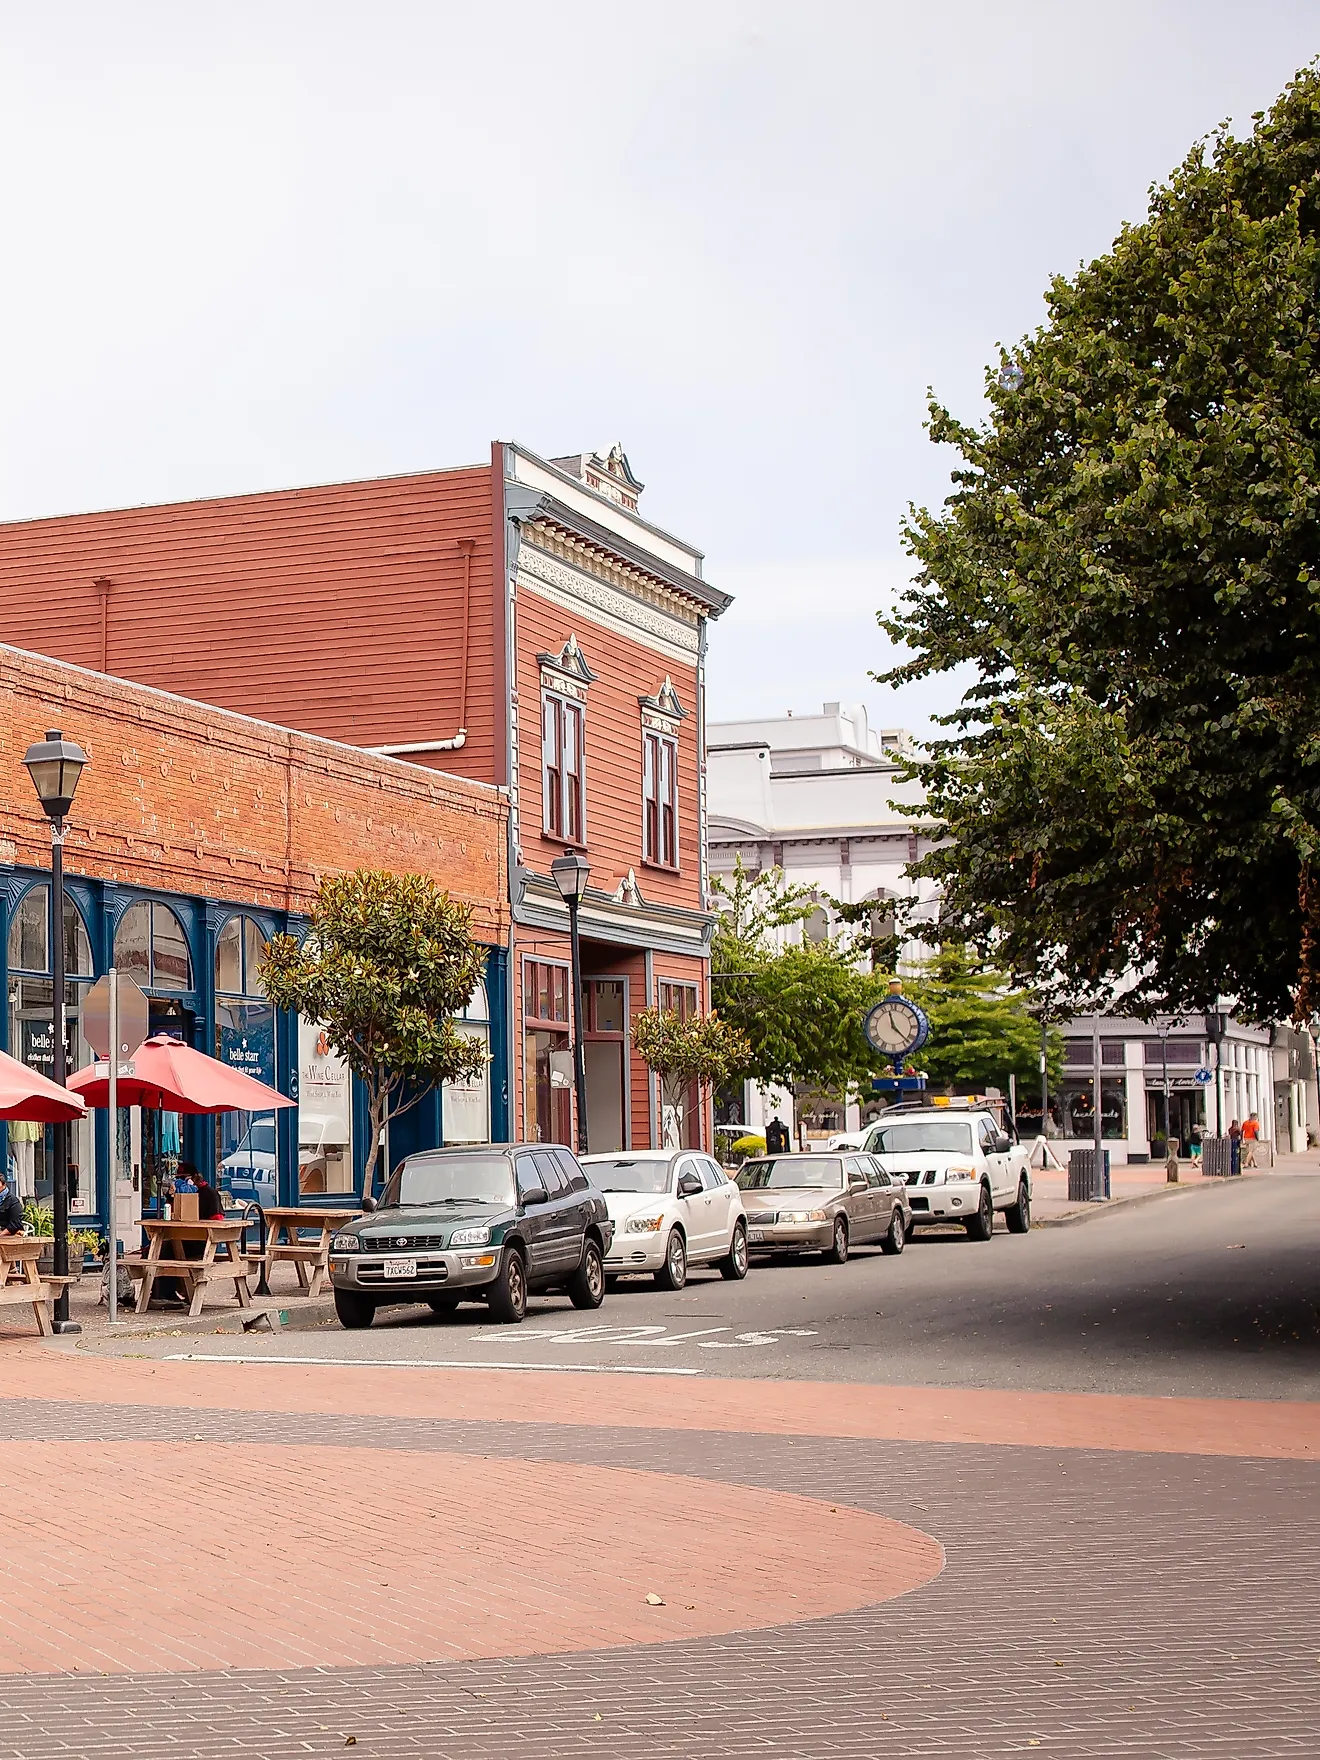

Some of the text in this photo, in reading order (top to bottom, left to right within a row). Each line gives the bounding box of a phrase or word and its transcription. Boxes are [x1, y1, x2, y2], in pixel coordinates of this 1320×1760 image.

[31, 1033, 50, 1048] belle
[230, 1047, 259, 1062] belle starr
[325, 1065, 345, 1081] CELLAR
